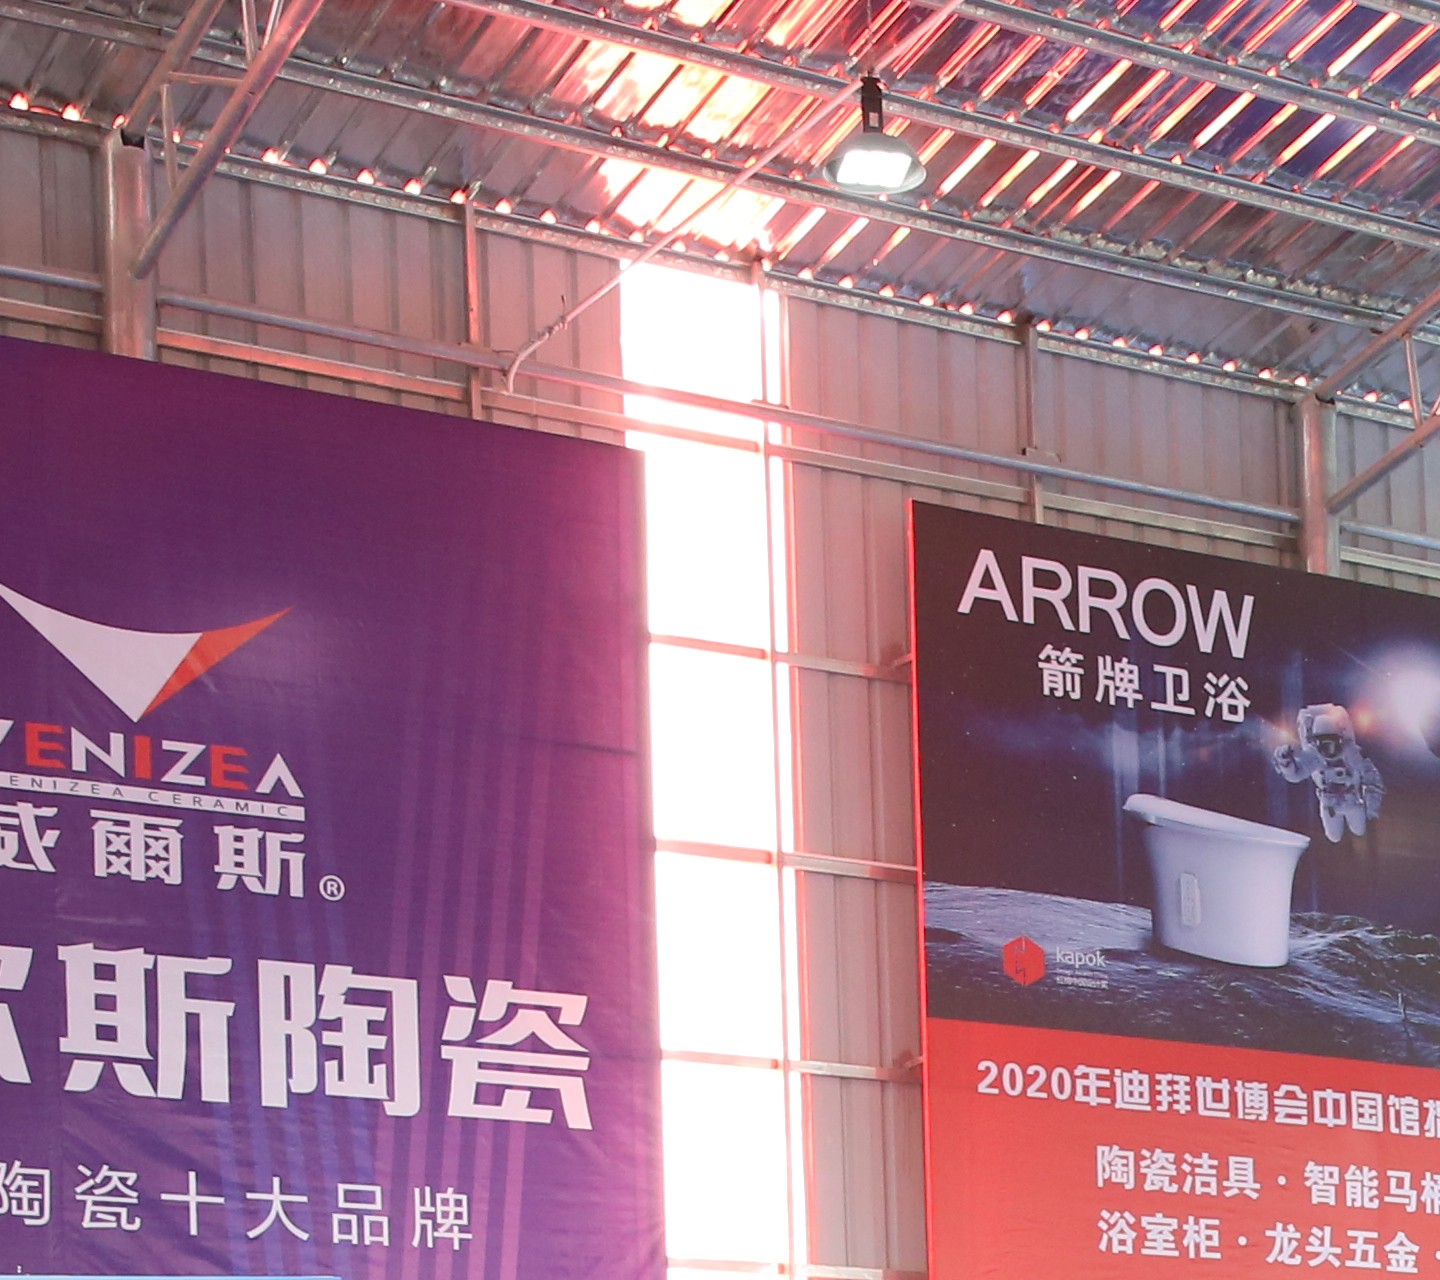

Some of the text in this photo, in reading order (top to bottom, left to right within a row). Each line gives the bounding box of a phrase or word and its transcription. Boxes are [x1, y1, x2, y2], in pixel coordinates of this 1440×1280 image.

[957, 548, 1255, 661] ARROW
[1037, 644, 1252, 724] 箭牌卫浴
[148, 789, 289, 818] CERAMIC
[1055, 946, 1106, 969] kapok
